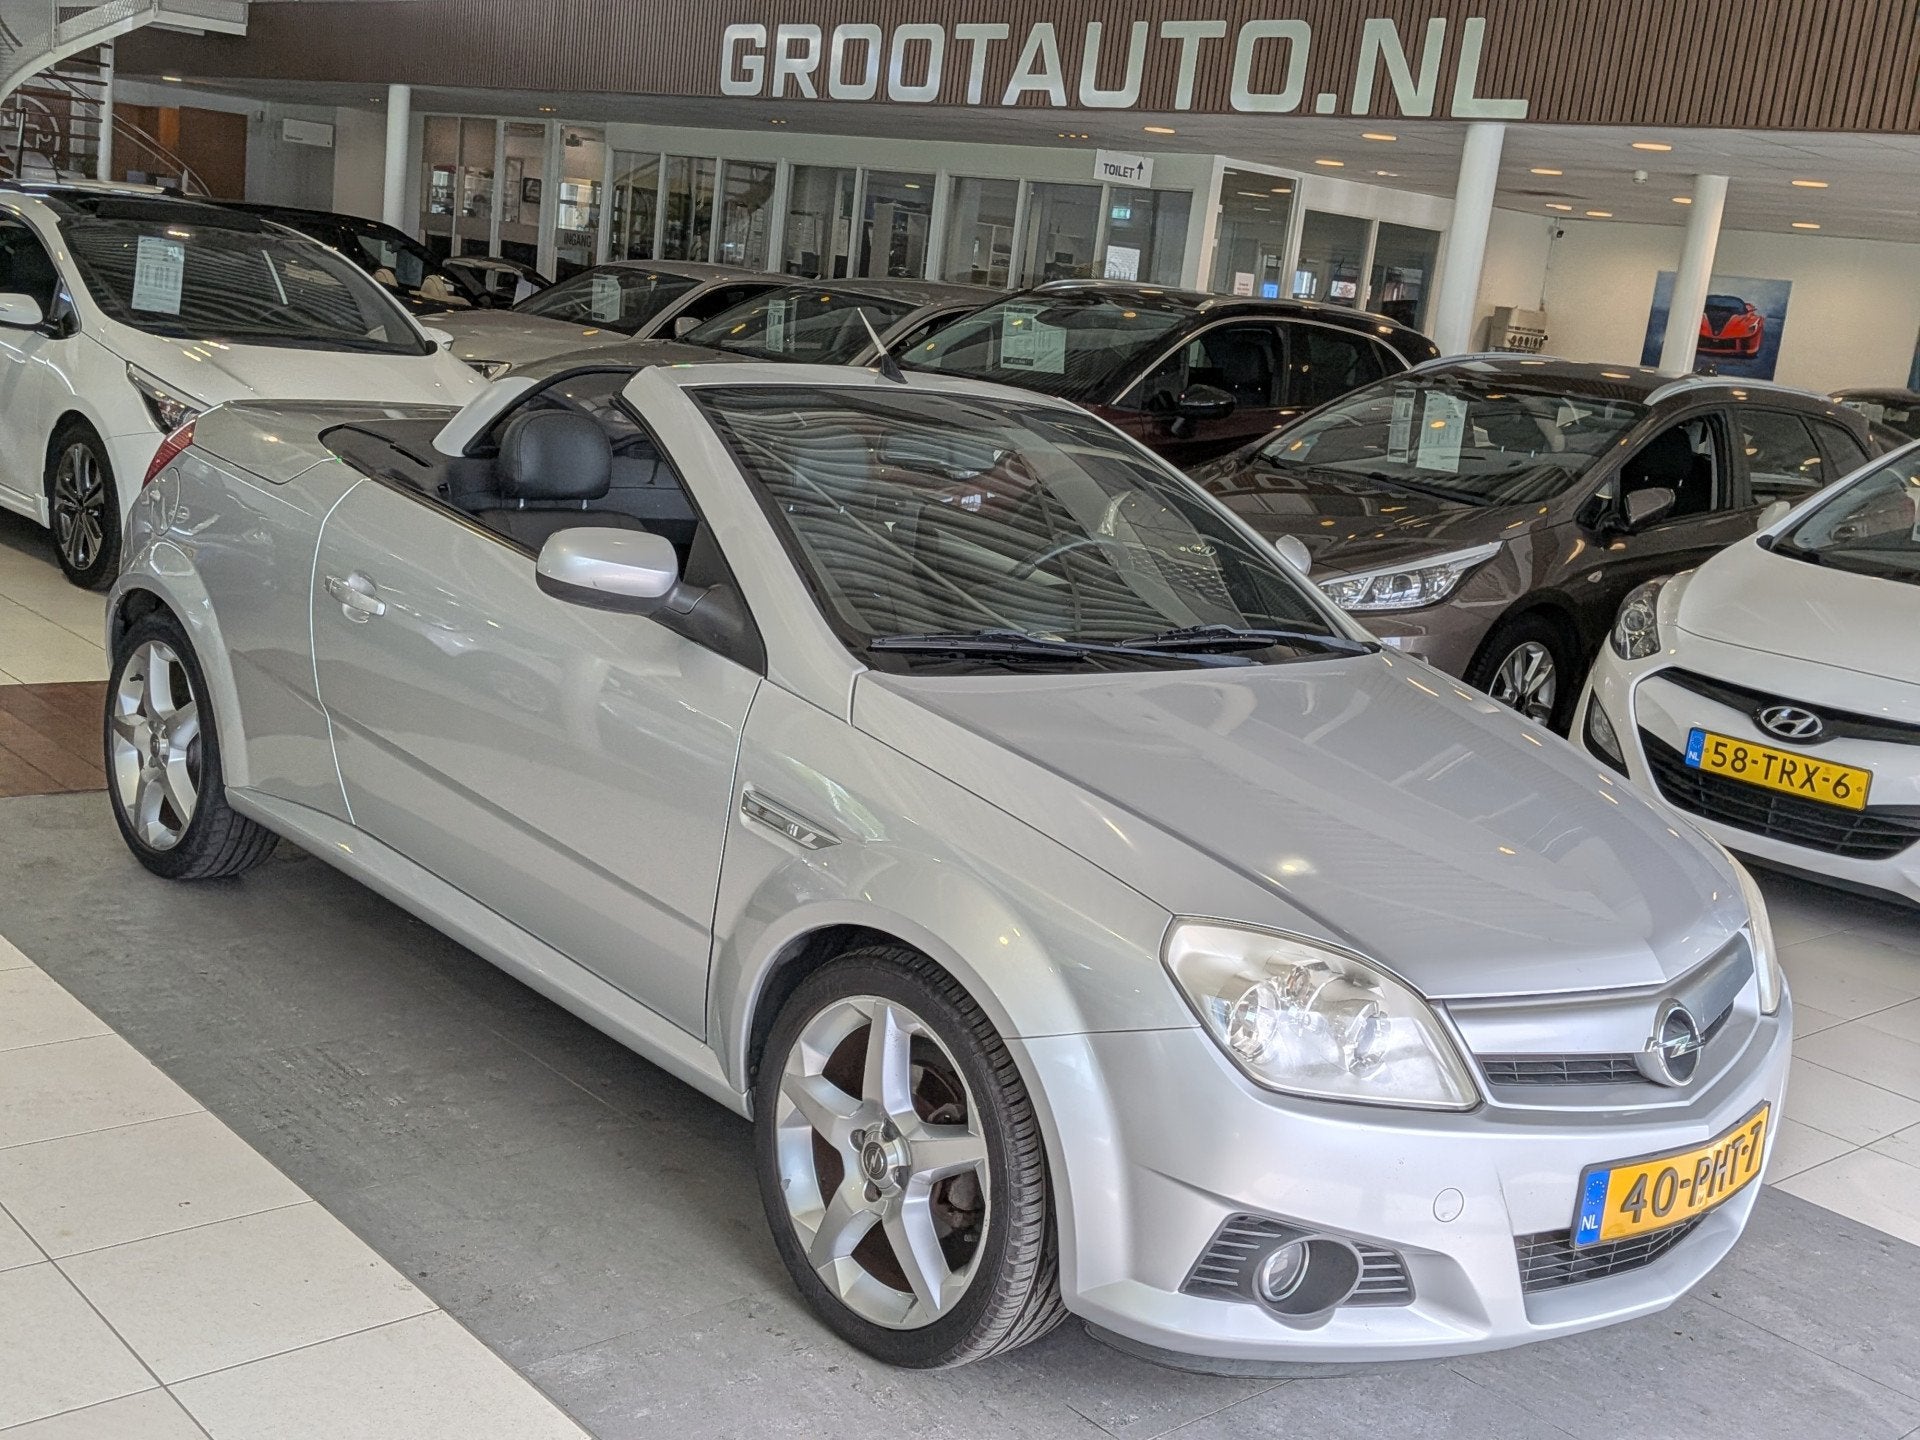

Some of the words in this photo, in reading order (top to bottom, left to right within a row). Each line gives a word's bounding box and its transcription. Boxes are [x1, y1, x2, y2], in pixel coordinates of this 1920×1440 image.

[719, 17, 1529, 119] GROOTAUTO.NL
[1103, 163, 1135, 178] TOILET
[1687, 751, 1700, 761] NL
[1711, 741, 1851, 799] 58-TRX-6
[1620, 1120, 1763, 1224] 40-PHT-7
[1581, 1214, 1599, 1232] NL
